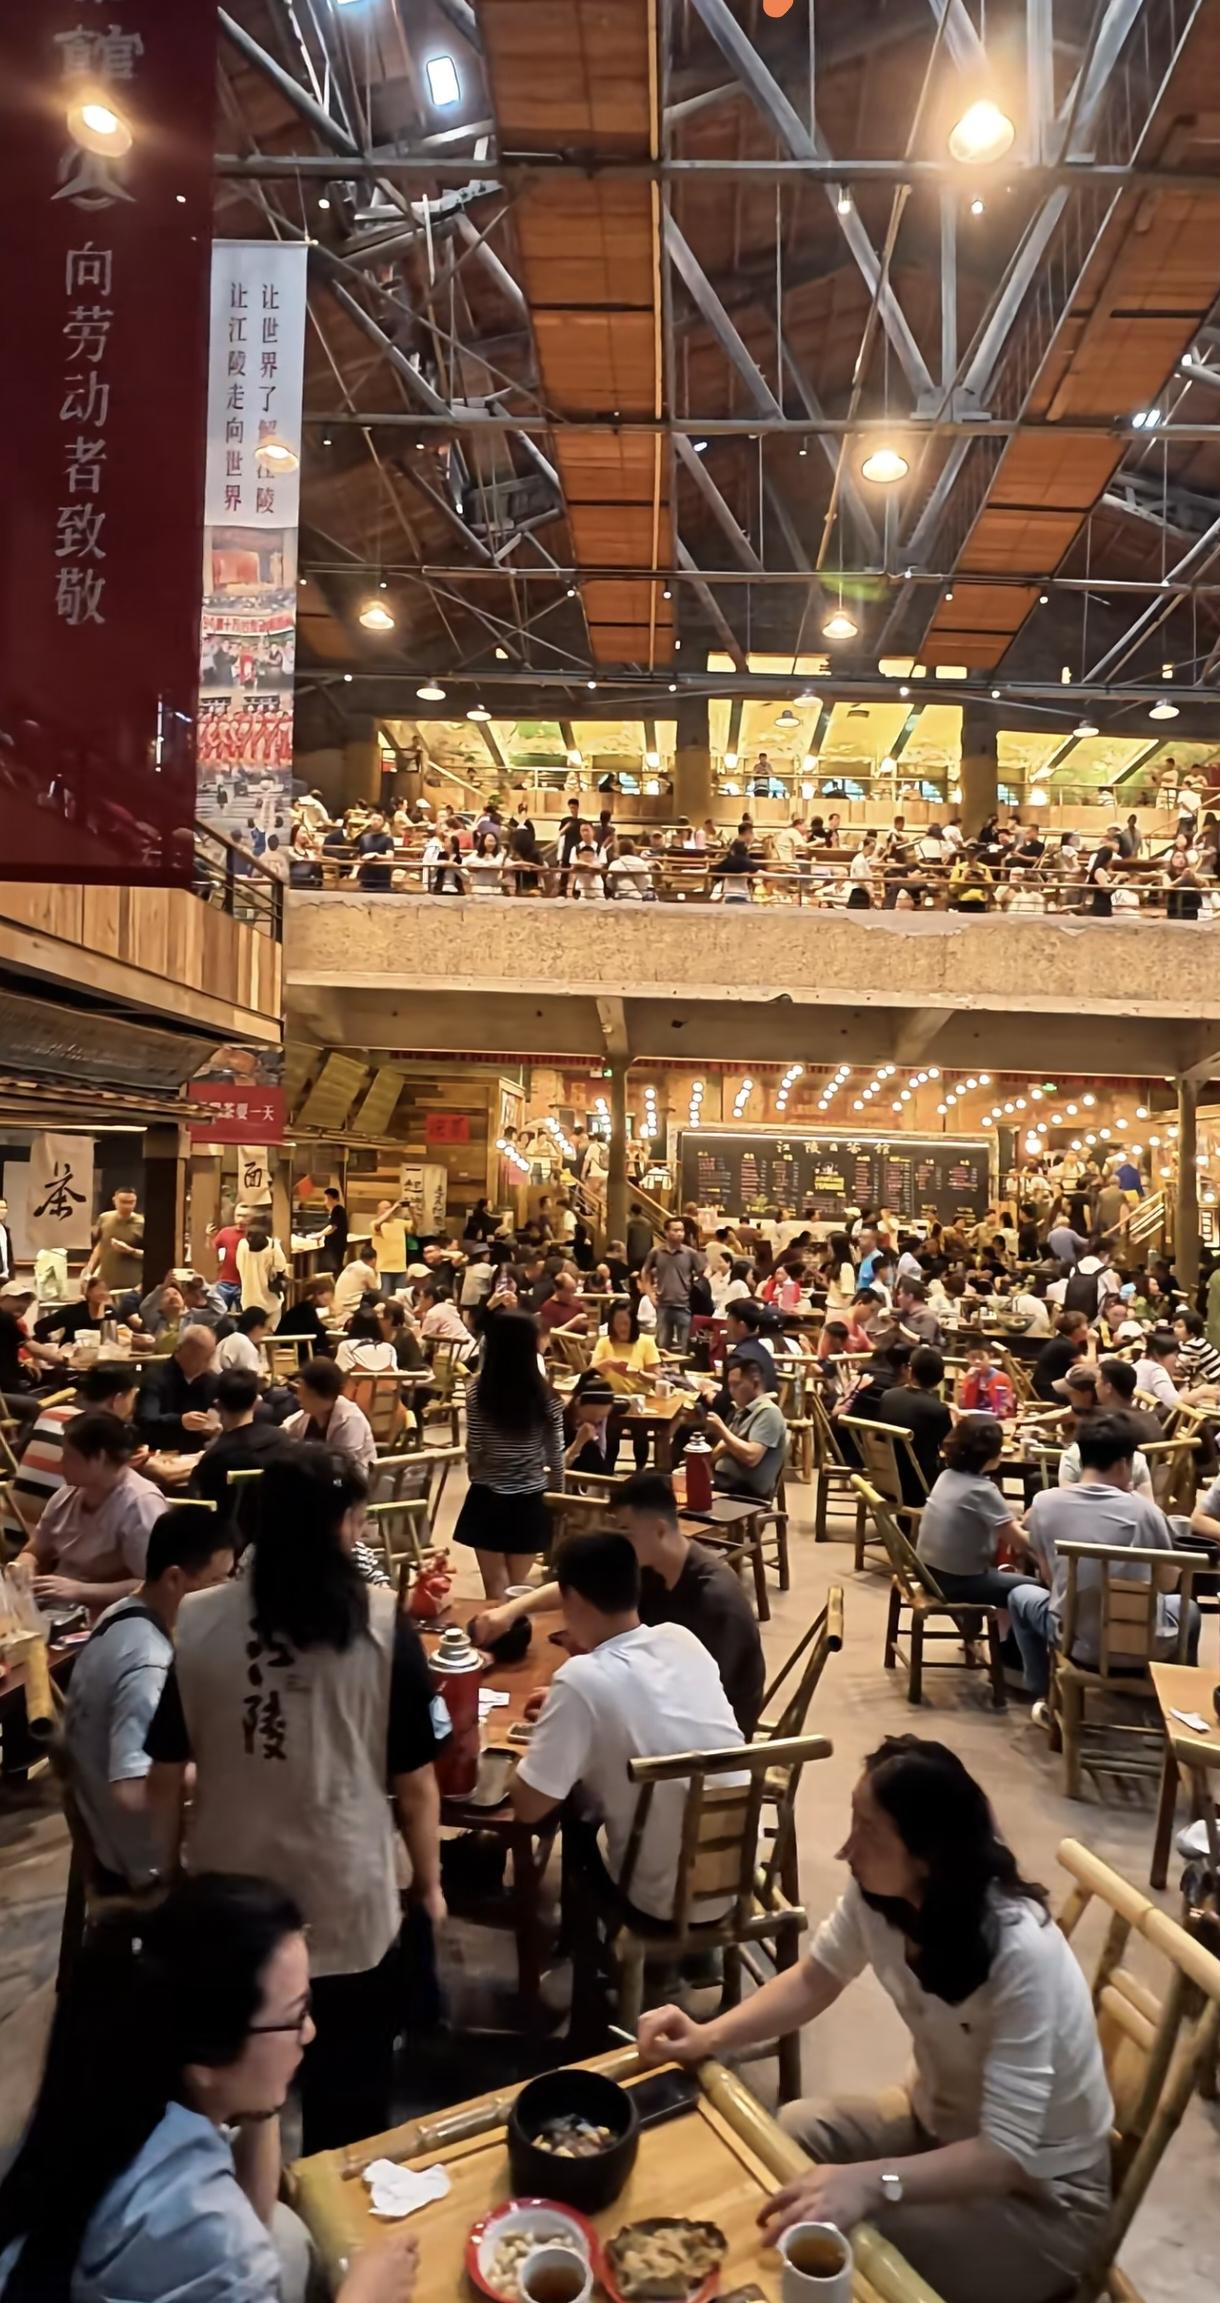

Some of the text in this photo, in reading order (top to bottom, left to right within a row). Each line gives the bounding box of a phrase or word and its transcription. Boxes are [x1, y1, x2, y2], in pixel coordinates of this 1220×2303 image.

[55, 244, 114, 627] 向劳动者致敬
[223, 282, 249, 513] 让江陵走向世界
[33, 1160, 87, 1222] 茶
[244, 1161, 263, 1189] 面
